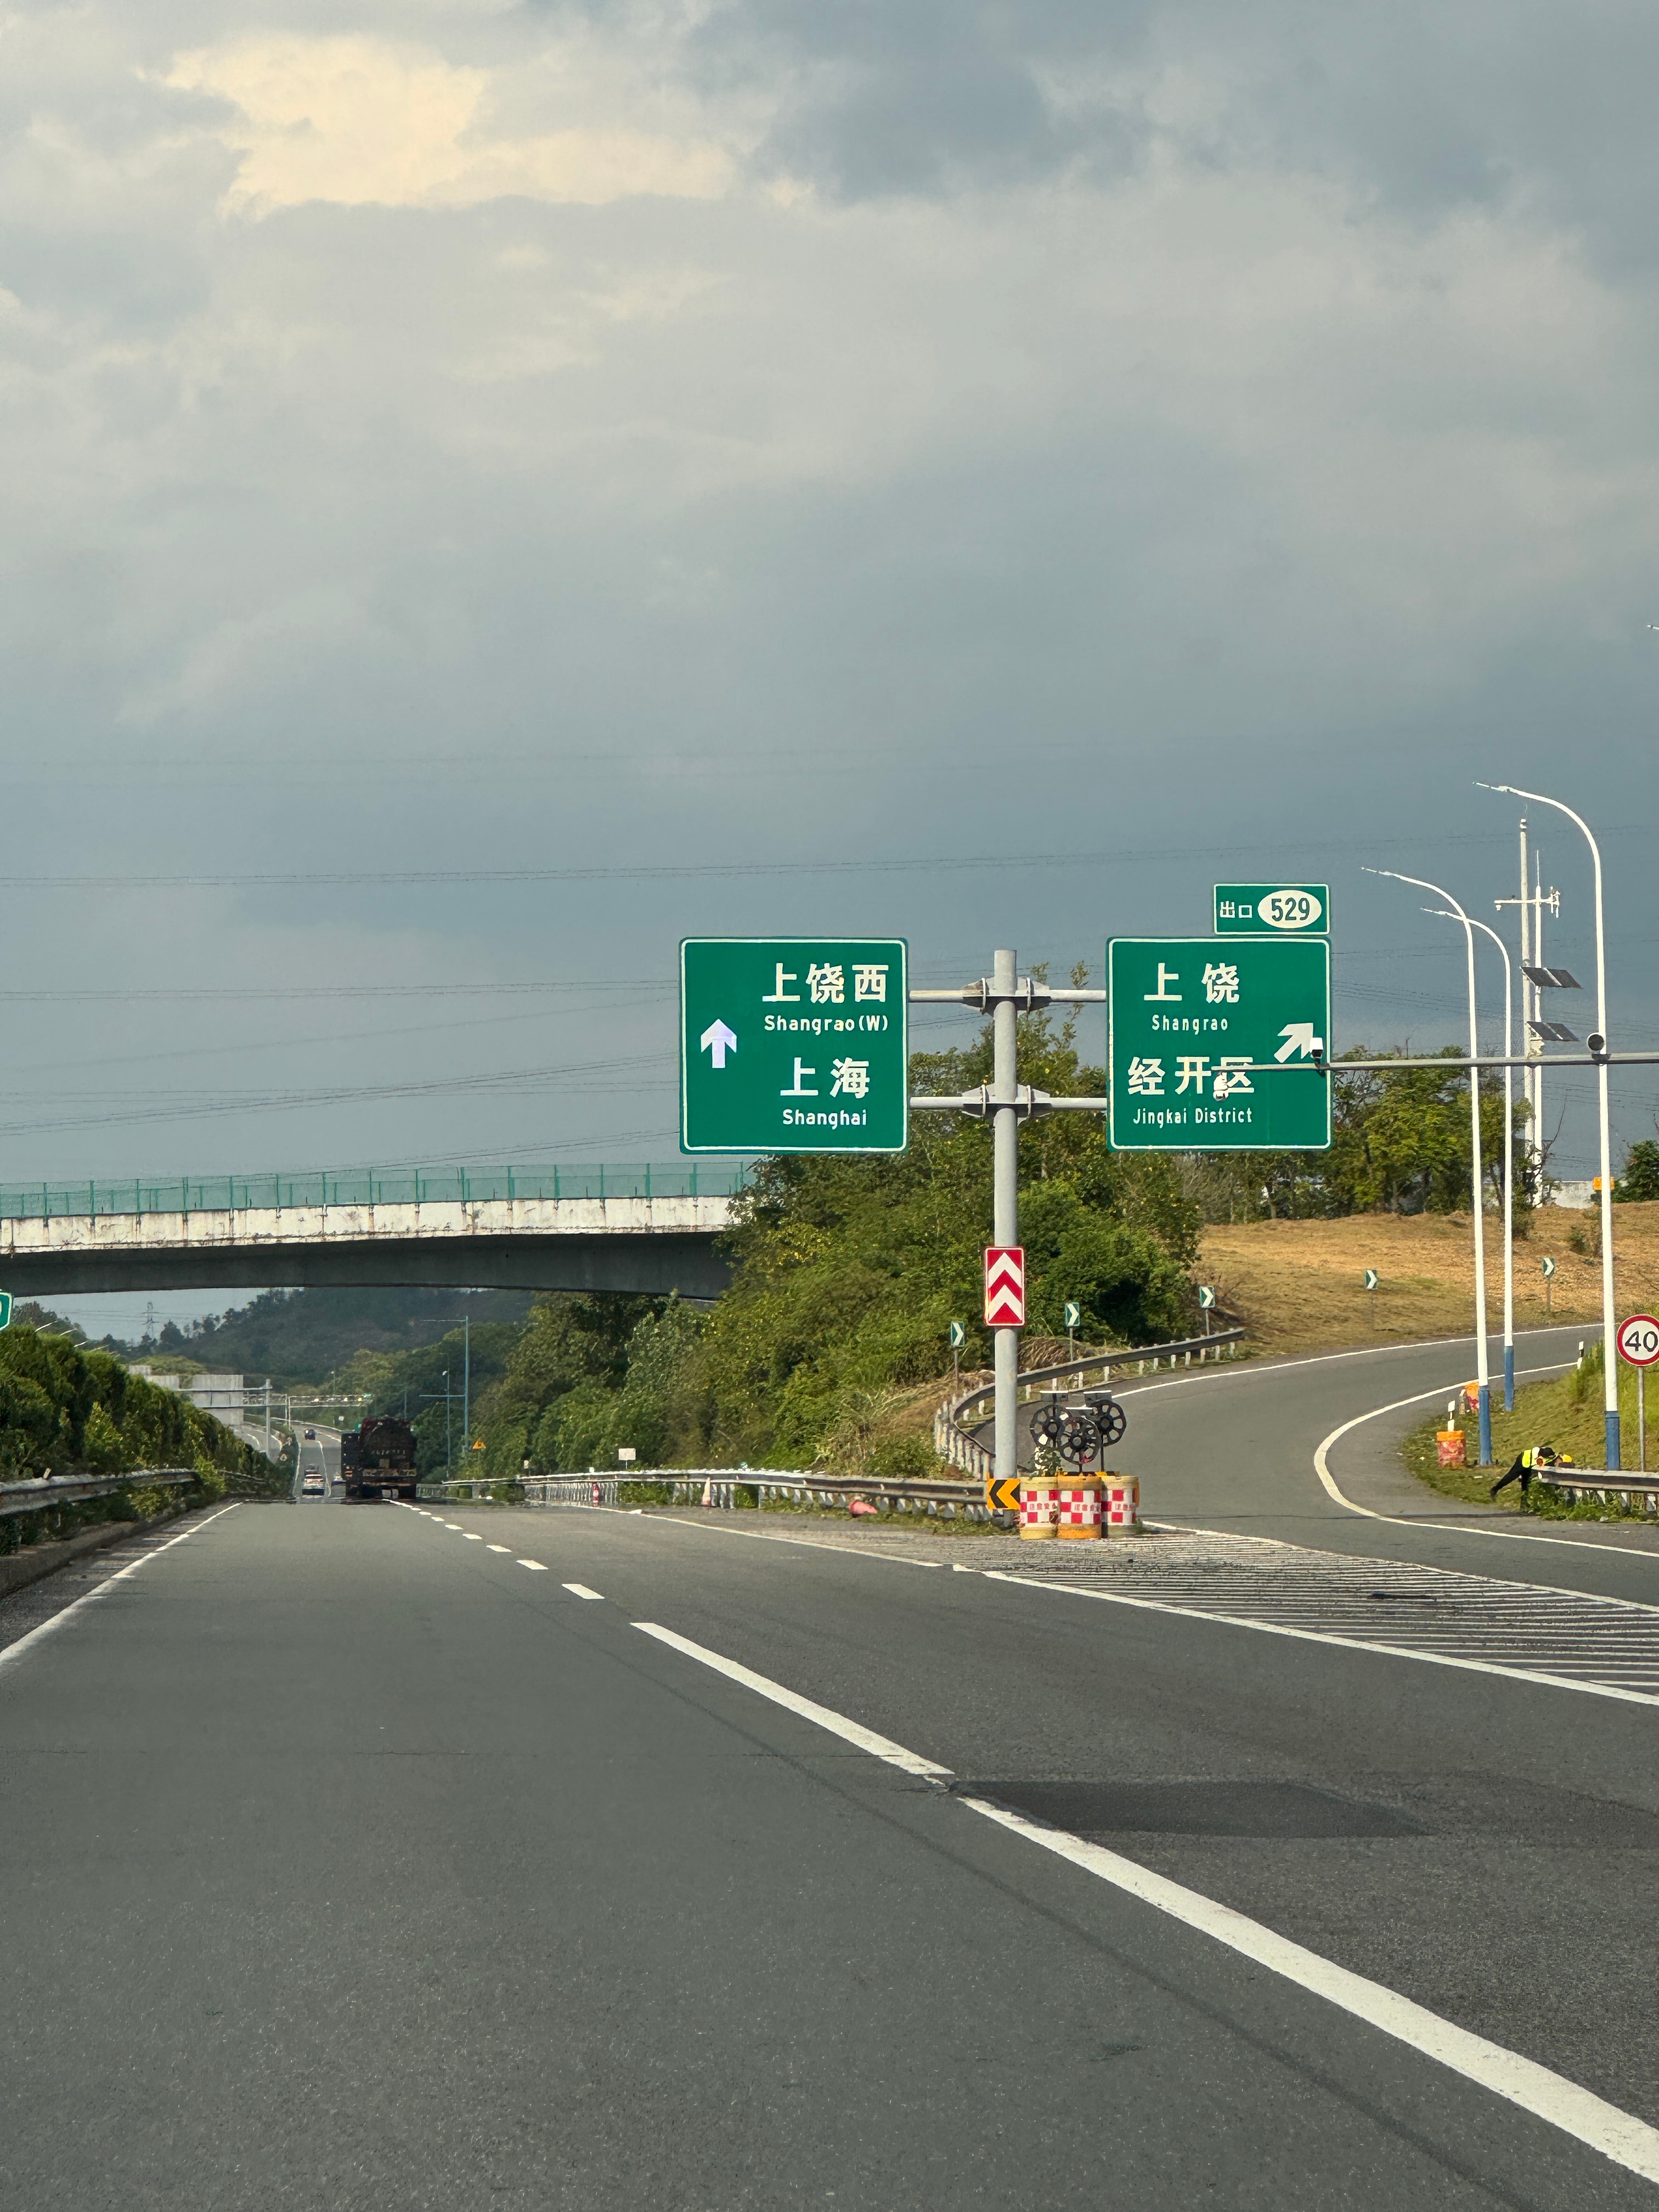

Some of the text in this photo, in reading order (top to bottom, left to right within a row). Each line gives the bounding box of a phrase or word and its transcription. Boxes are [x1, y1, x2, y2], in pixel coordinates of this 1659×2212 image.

[1220, 898, 1310, 922] 出口 529
[762, 963, 889, 1003] 上饶西
[1144, 963, 1240, 1003] 上饶
[764, 1015, 888, 1035] Shangrao(W)
[1152, 1014, 1228, 1035] Shangrao
[780, 1057, 870, 1098] 上海
[1128, 1057, 1255, 1094] 经开区
[783, 1109, 867, 1130] Shanghai
[1133, 1108, 1252, 1128] Jingkai District
[1624, 1330, 1658, 1352] 40
